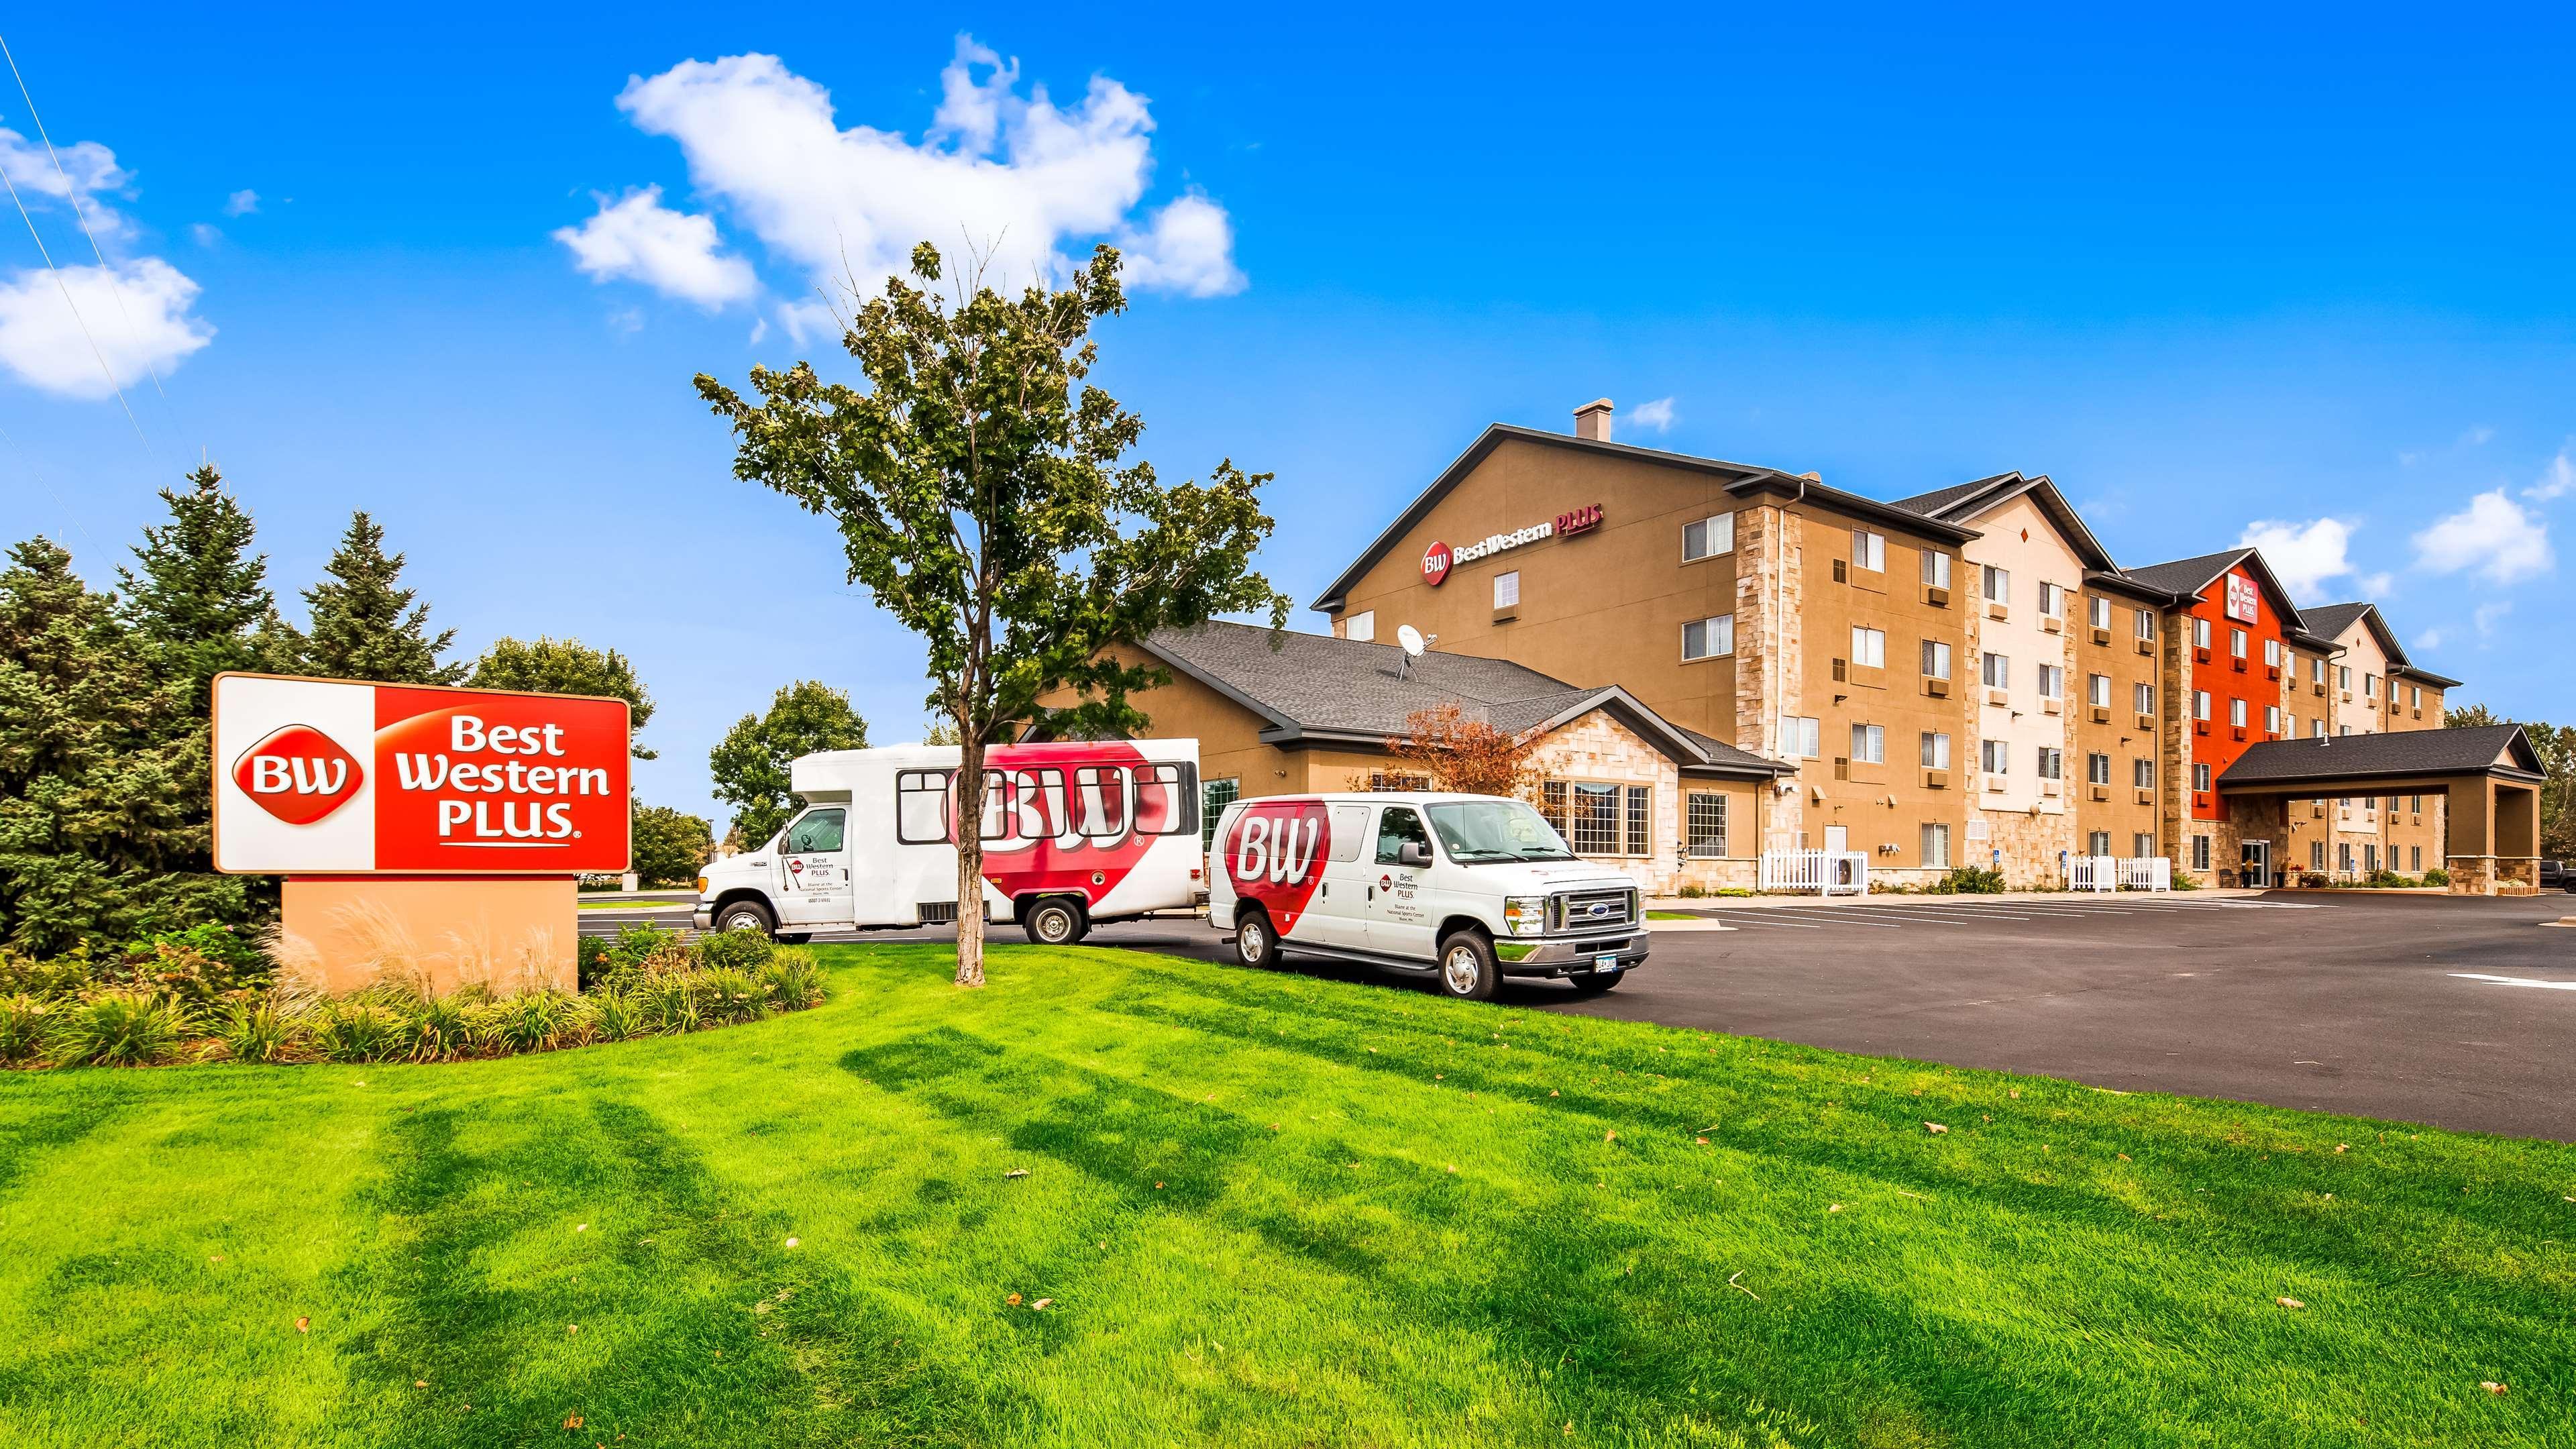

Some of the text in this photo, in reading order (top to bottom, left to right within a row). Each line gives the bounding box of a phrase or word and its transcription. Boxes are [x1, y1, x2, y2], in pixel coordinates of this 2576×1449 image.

[1454, 503, 1601, 565] Best Western PLUS
[1425, 553, 1446, 574] BW
[2239, 592, 2257, 606] Western
[2243, 584, 2254, 596] Best
[2243, 604, 2254, 615] PLUS
[451, 715, 566, 756] Best
[252, 755, 347, 795] BW
[394, 752, 610, 796] Western
[439, 800, 574, 839] PLUS
[979, 766, 1134, 852] BW
[1237, 816, 1318, 884] BW
[1381, 879, 1391, 888] BW
[1394, 880, 1418, 890] Western
[1399, 873, 1413, 882] Best
[1397, 890, 1413, 898] PLUS
